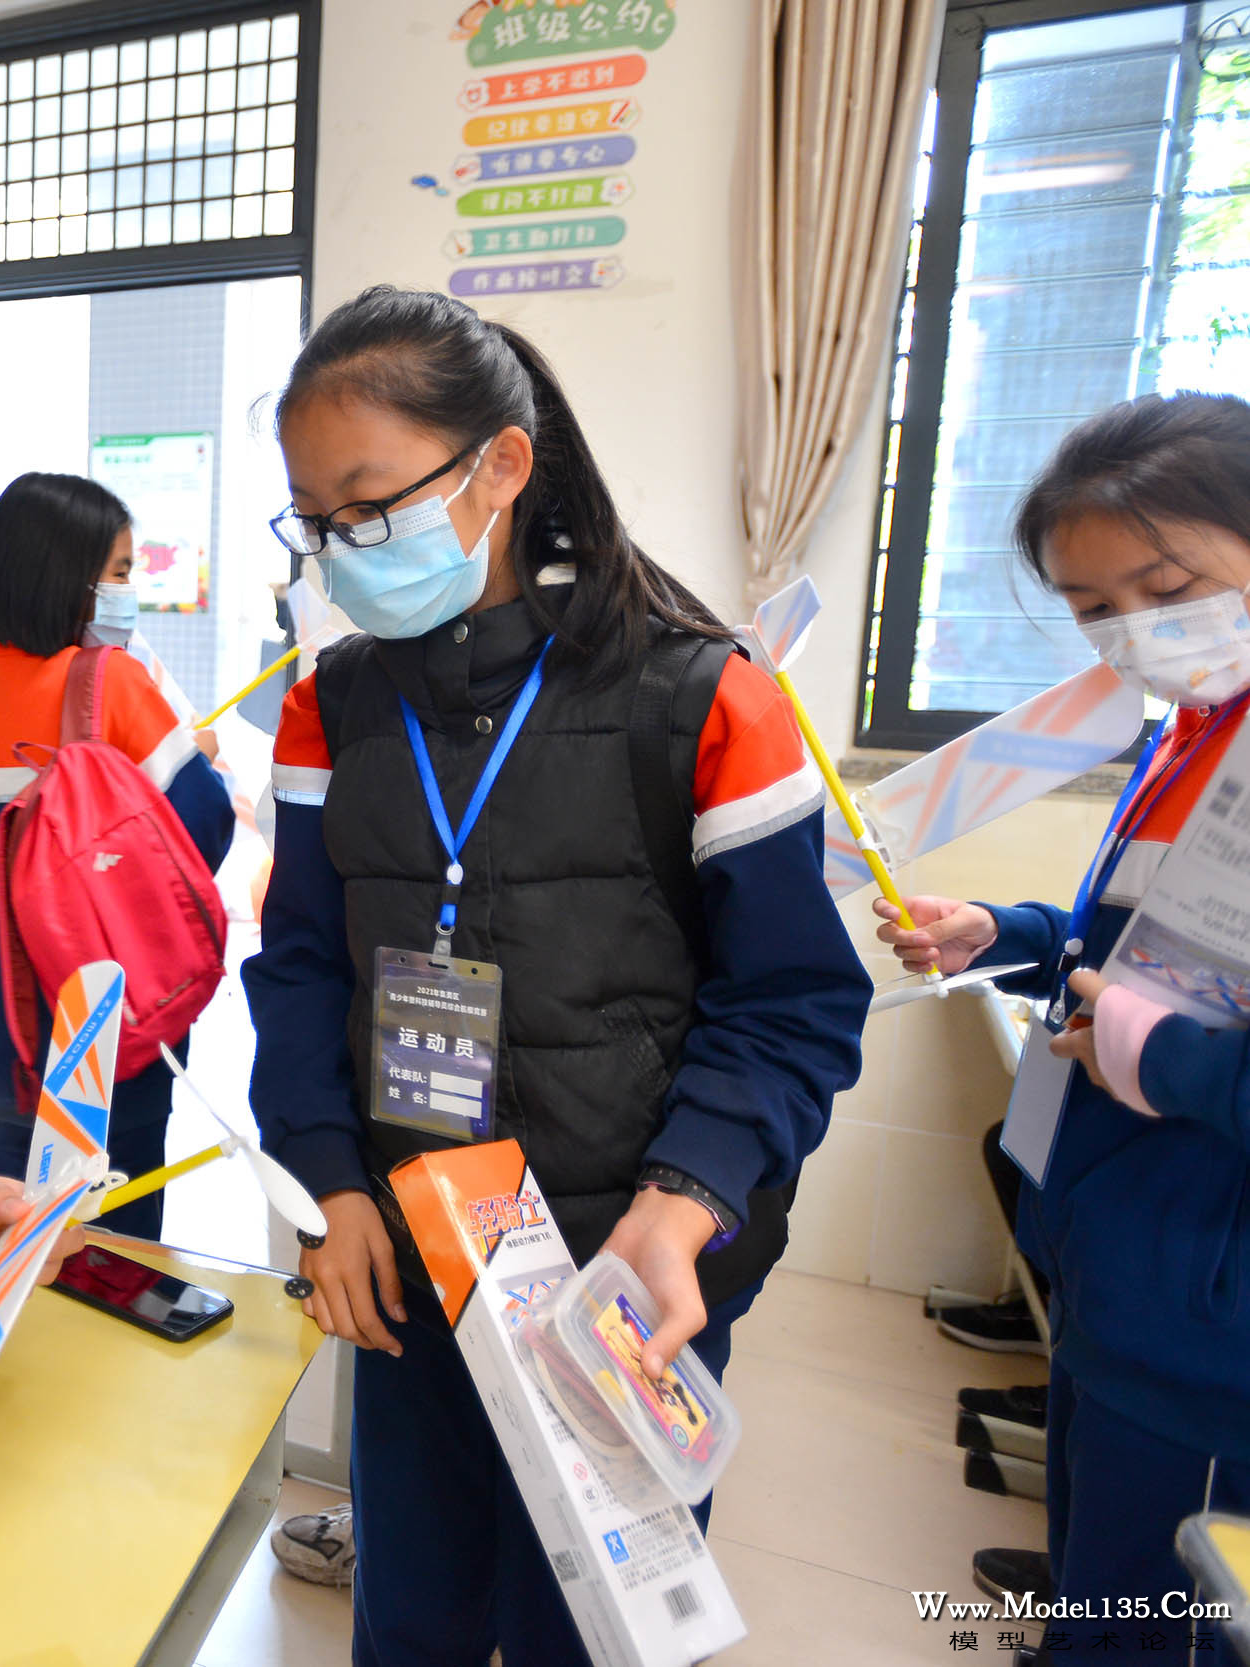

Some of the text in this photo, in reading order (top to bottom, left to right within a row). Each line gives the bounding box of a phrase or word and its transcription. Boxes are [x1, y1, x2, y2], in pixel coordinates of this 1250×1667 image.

[501, 66, 616, 99] 上学不迟到
[485, 225, 596, 251] 卫生勤打扫
[473, 265, 584, 291] 作业按时交
[398, 1027, 475, 1059] 运动员
[38, 1143, 54, 1185] LIGHT
[467, 1189, 547, 1248] 轻骑士
